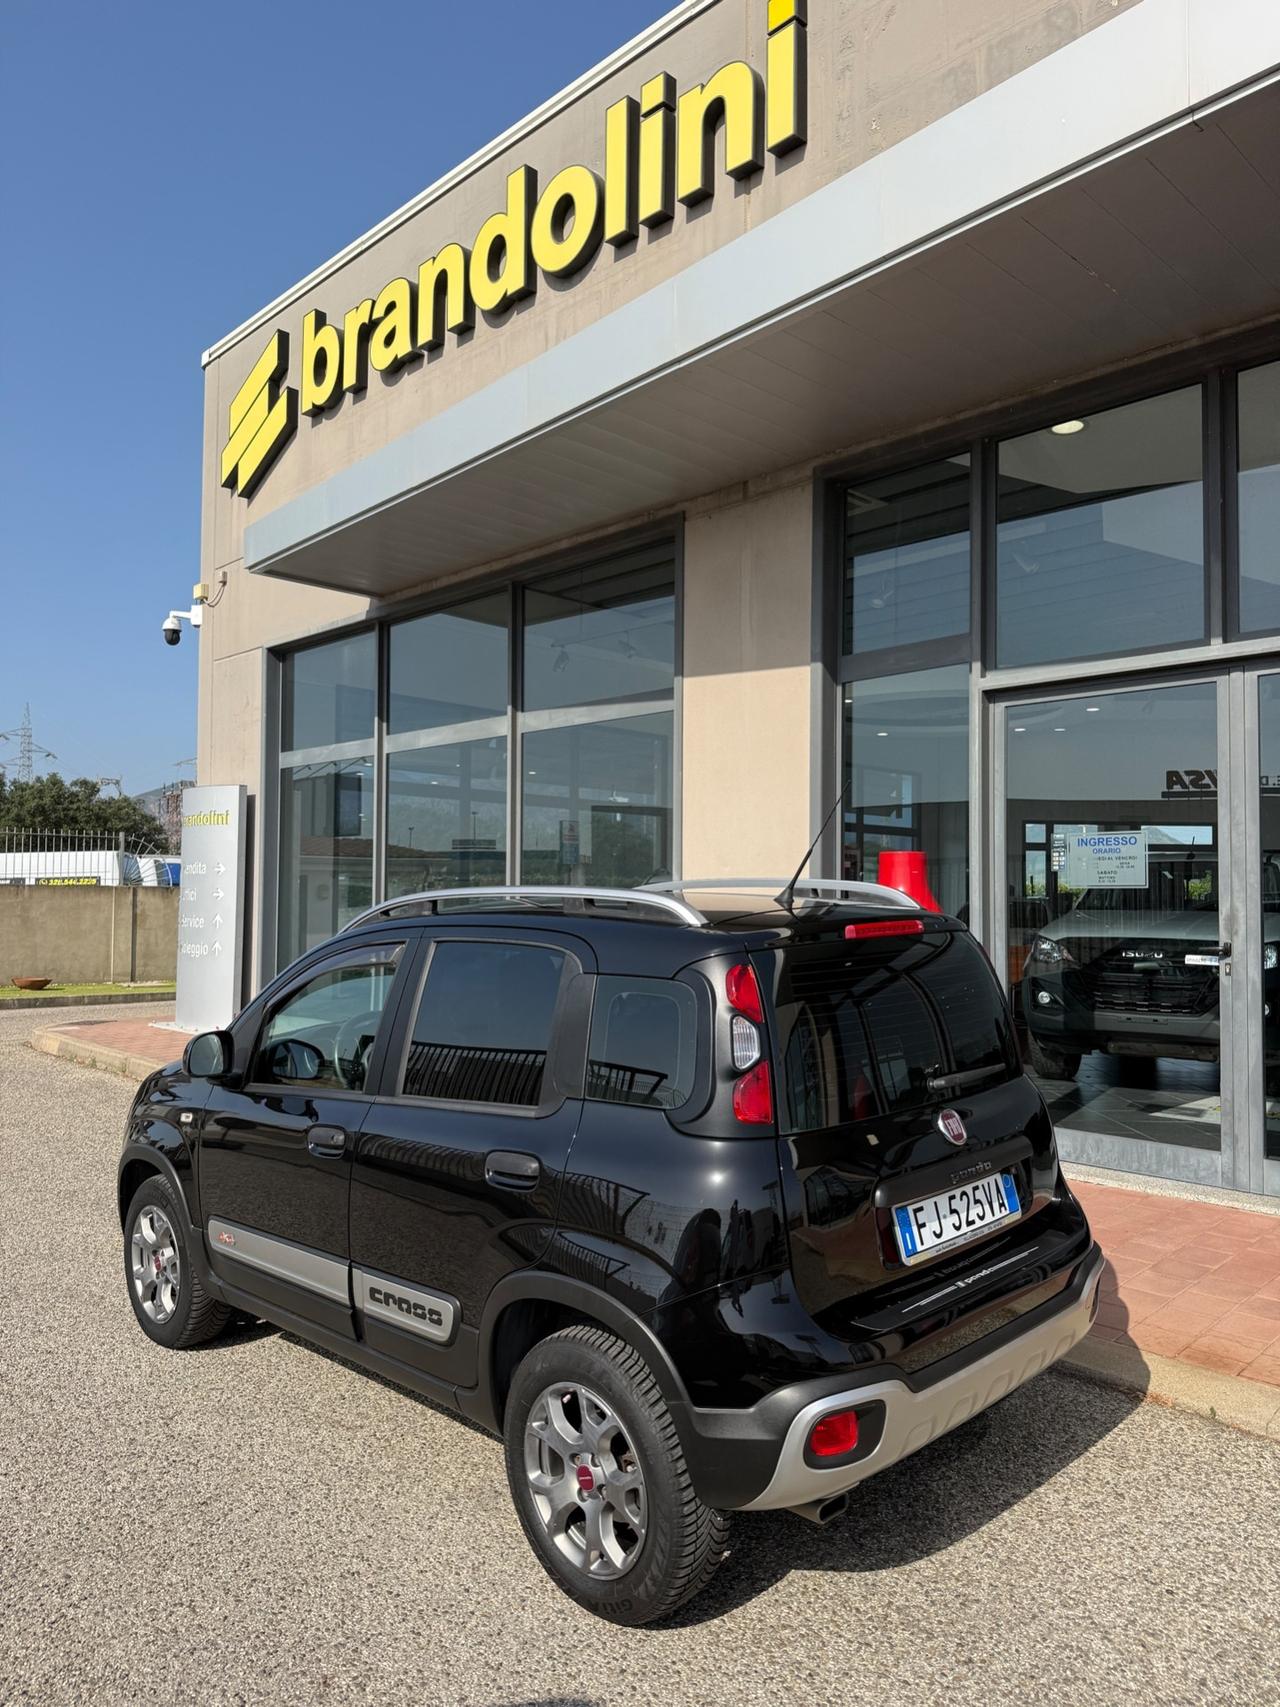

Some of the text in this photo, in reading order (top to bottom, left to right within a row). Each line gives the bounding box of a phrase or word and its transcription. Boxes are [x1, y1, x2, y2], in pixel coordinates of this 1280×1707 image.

[301, 0, 807, 417] brandolini
[1077, 836, 1138, 847] INGRESSO
[1092, 847, 1121, 855] ORARIO
